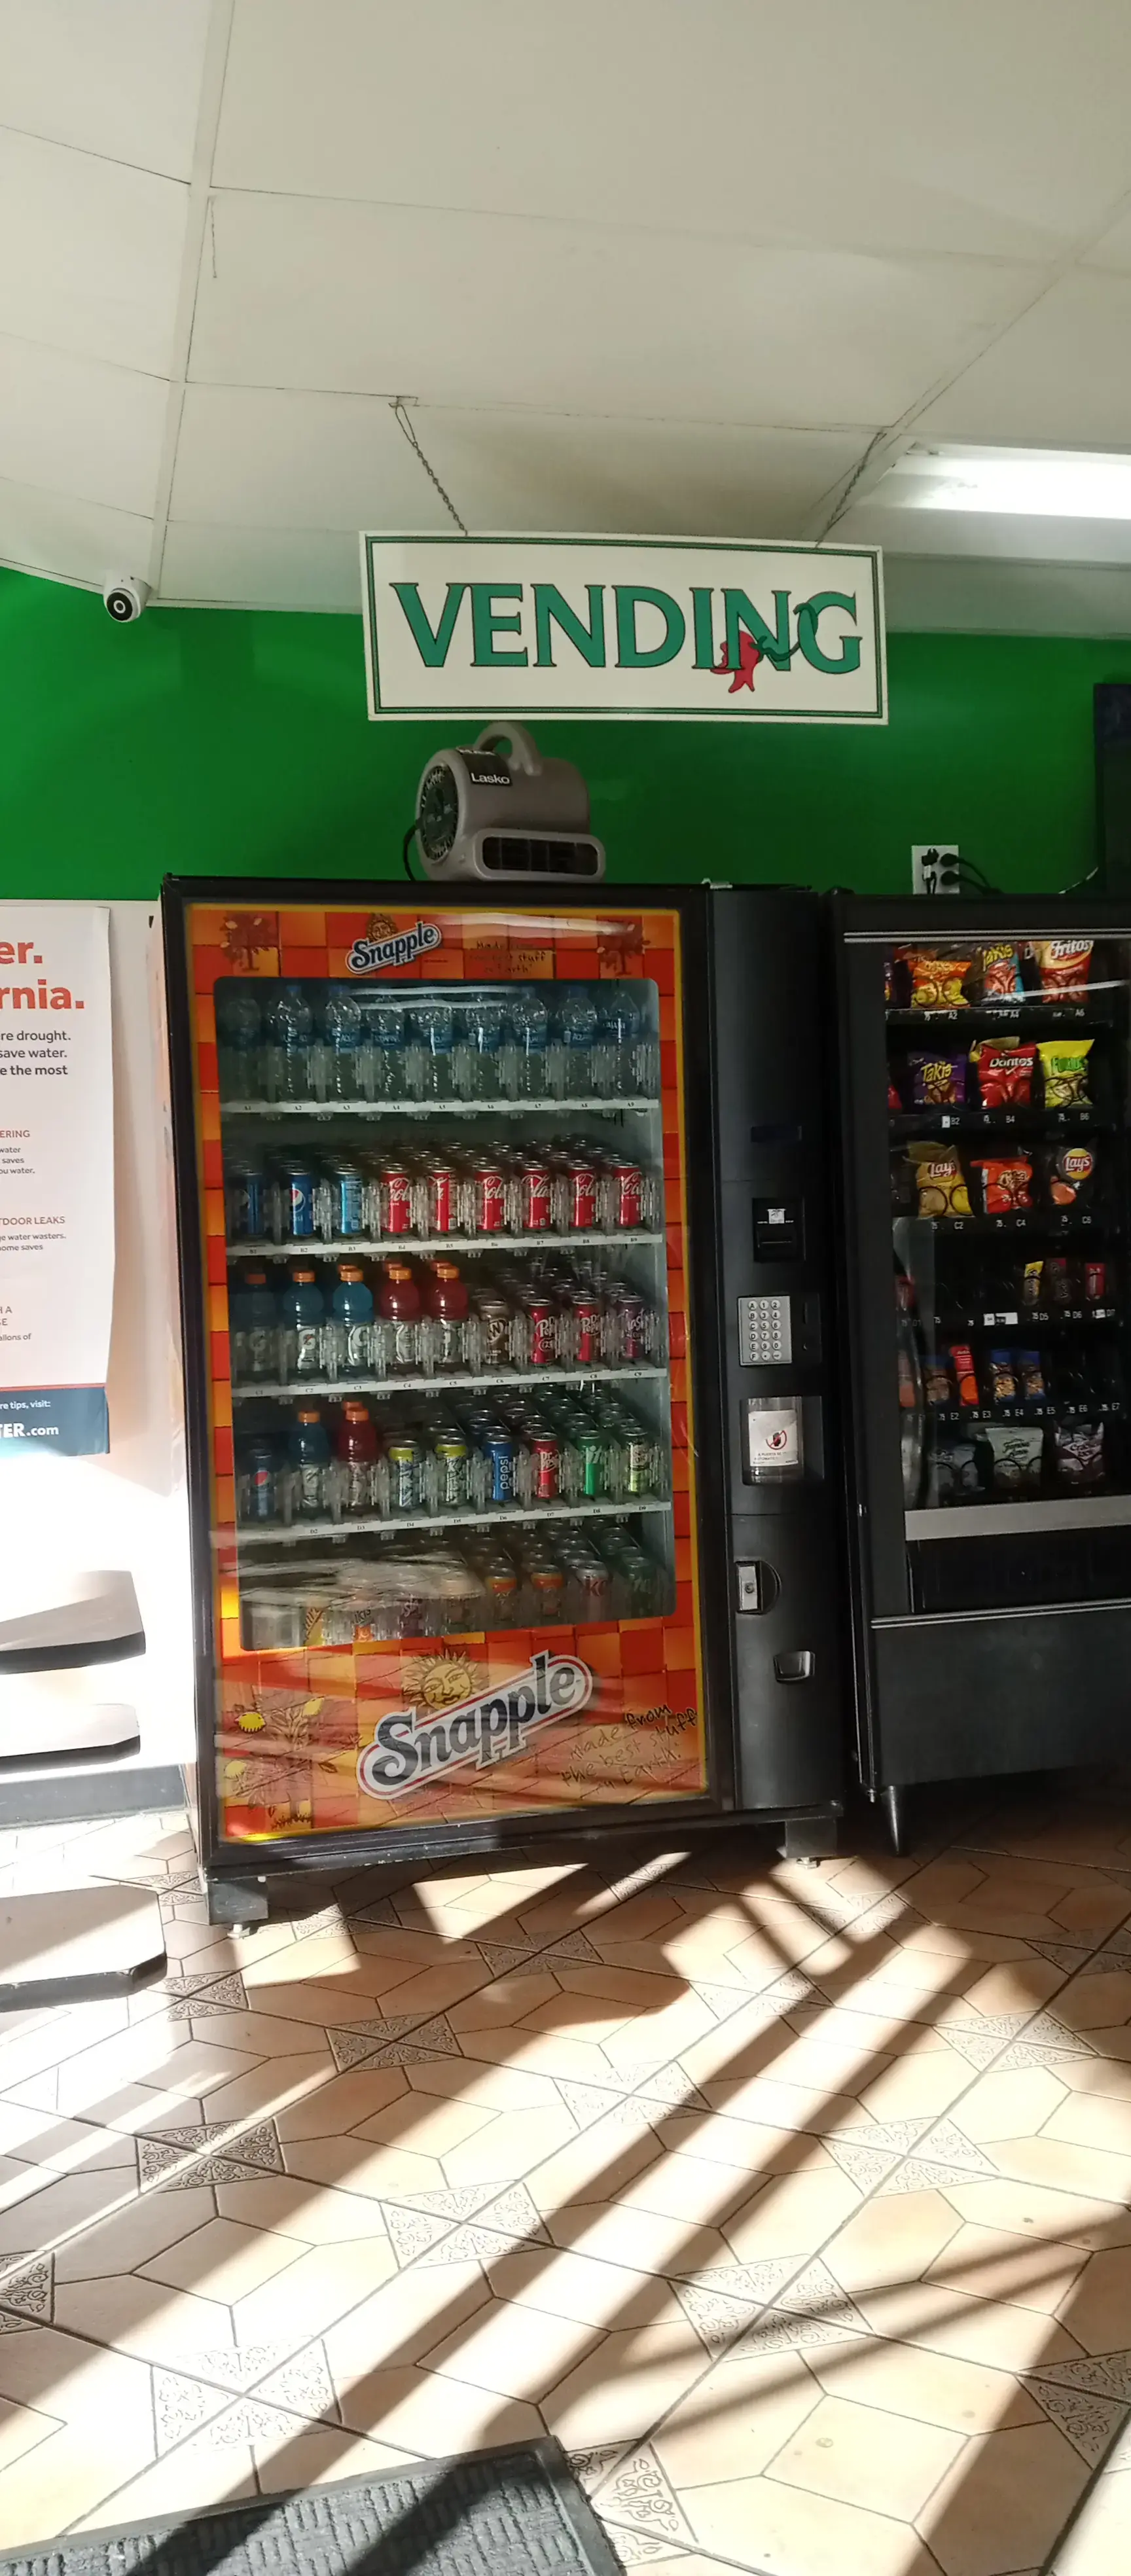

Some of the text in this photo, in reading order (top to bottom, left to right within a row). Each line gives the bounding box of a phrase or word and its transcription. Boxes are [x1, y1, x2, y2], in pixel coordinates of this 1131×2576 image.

[388, 582, 863, 675] VENDING
[471, 772, 510, 785] Lasko
[351, 923, 435, 970] Snapple
[1051, 940, 1094, 959] Fritos
[16, 1030, 71, 1044] drought.
[28, 1048, 67, 1058] water.
[10, 1065, 32, 1075] the
[35, 1065, 68, 1075] most
[920, 1060, 952, 1082] Takis
[34, 1216, 65, 1225] LEAKS
[498, 1456, 510, 1490] pepsi
[371, 1657, 578, 1787] Snapple
[625, 1704, 673, 1730] from
[599, 1737, 642, 1768] best
[649, 1708, 698, 1747] stuff
